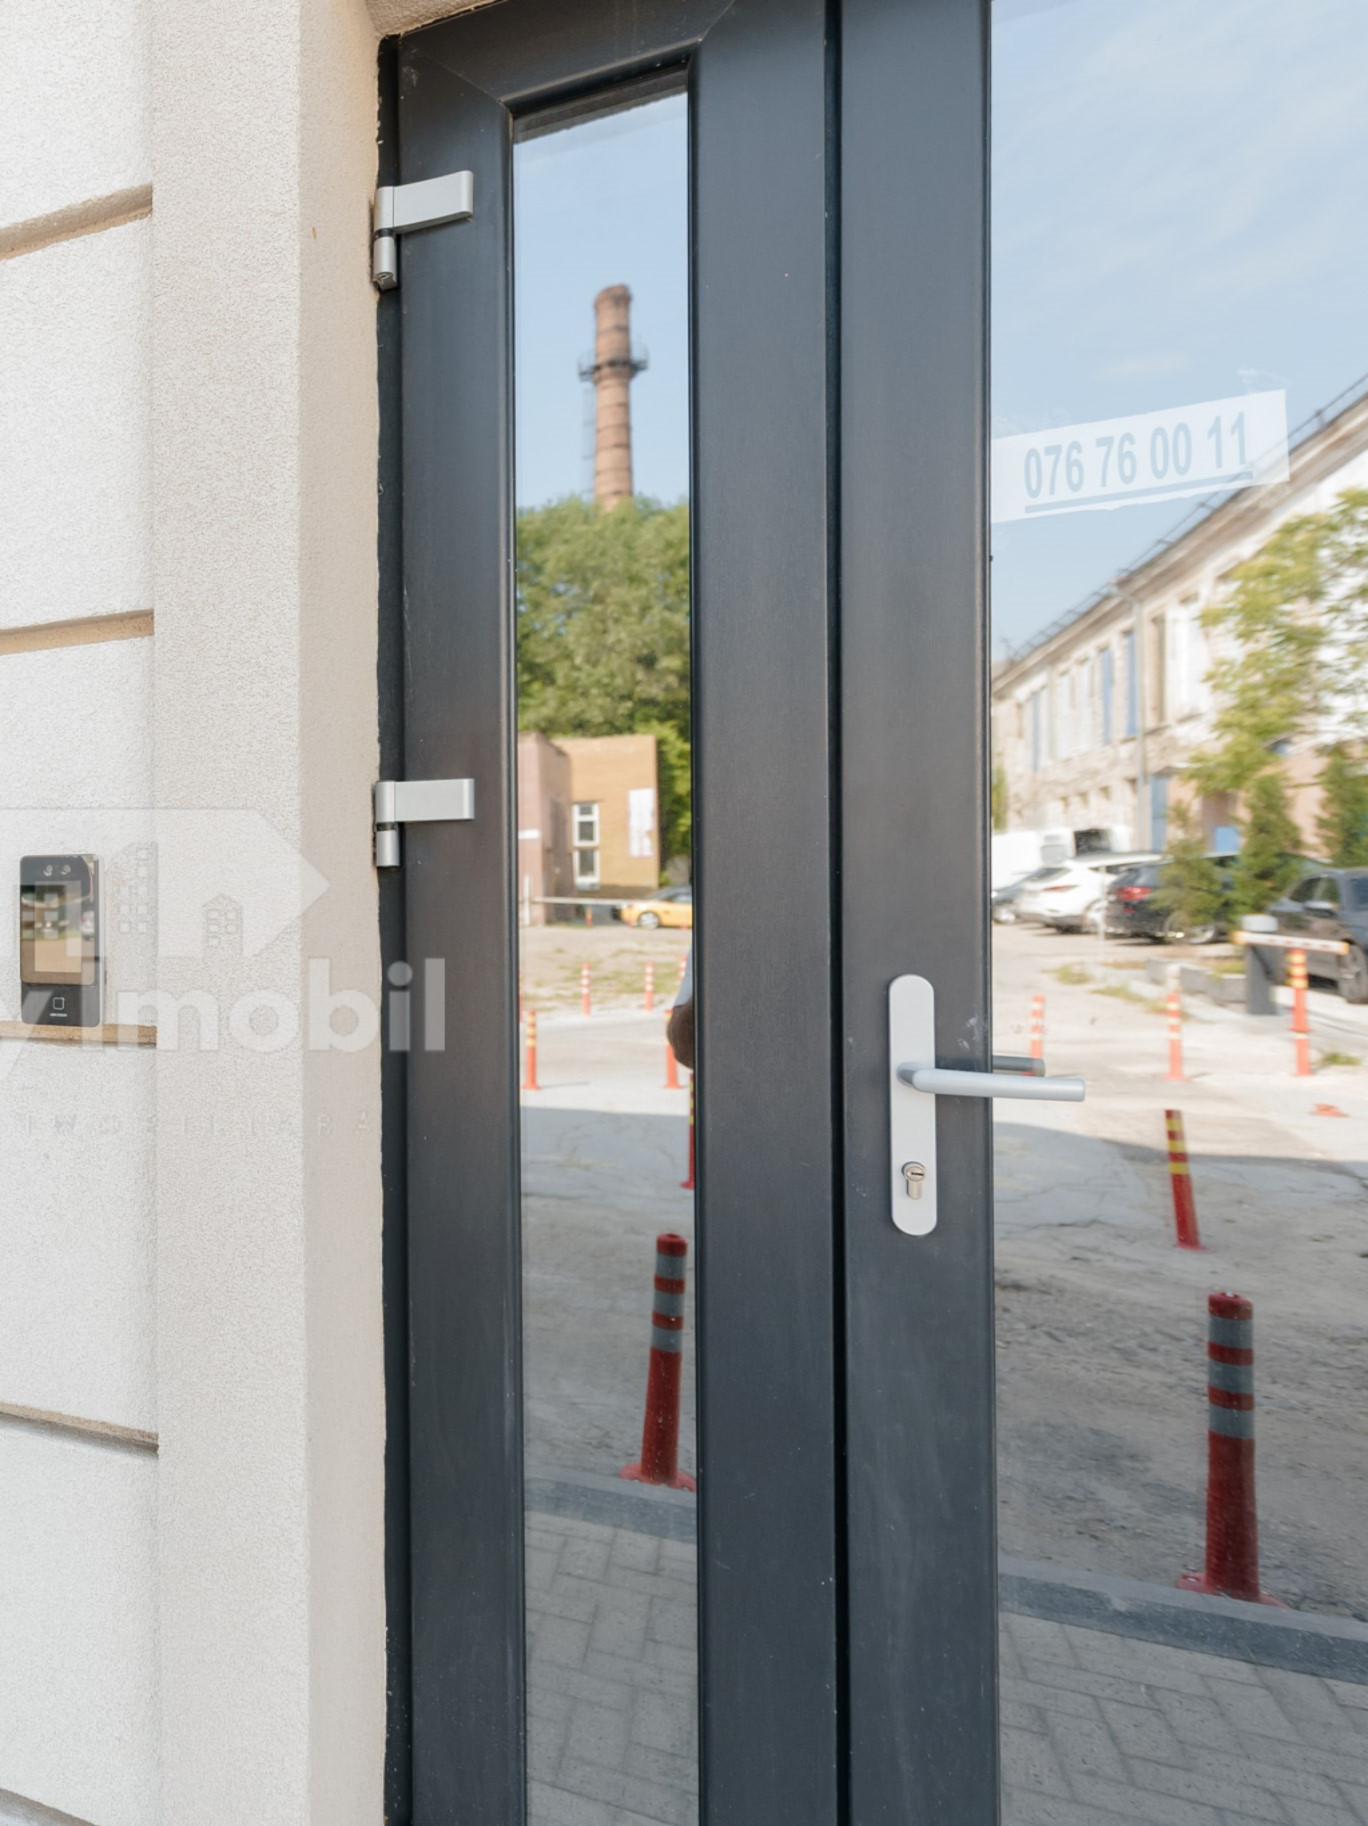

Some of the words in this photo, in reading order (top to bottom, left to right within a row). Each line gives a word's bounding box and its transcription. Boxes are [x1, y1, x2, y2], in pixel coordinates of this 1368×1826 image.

[1024, 440, 1085, 499] 076
[1095, 431, 1137, 488] 76
[1149, 422, 1192, 479] 00
[1207, 411, 1247, 469] 11
